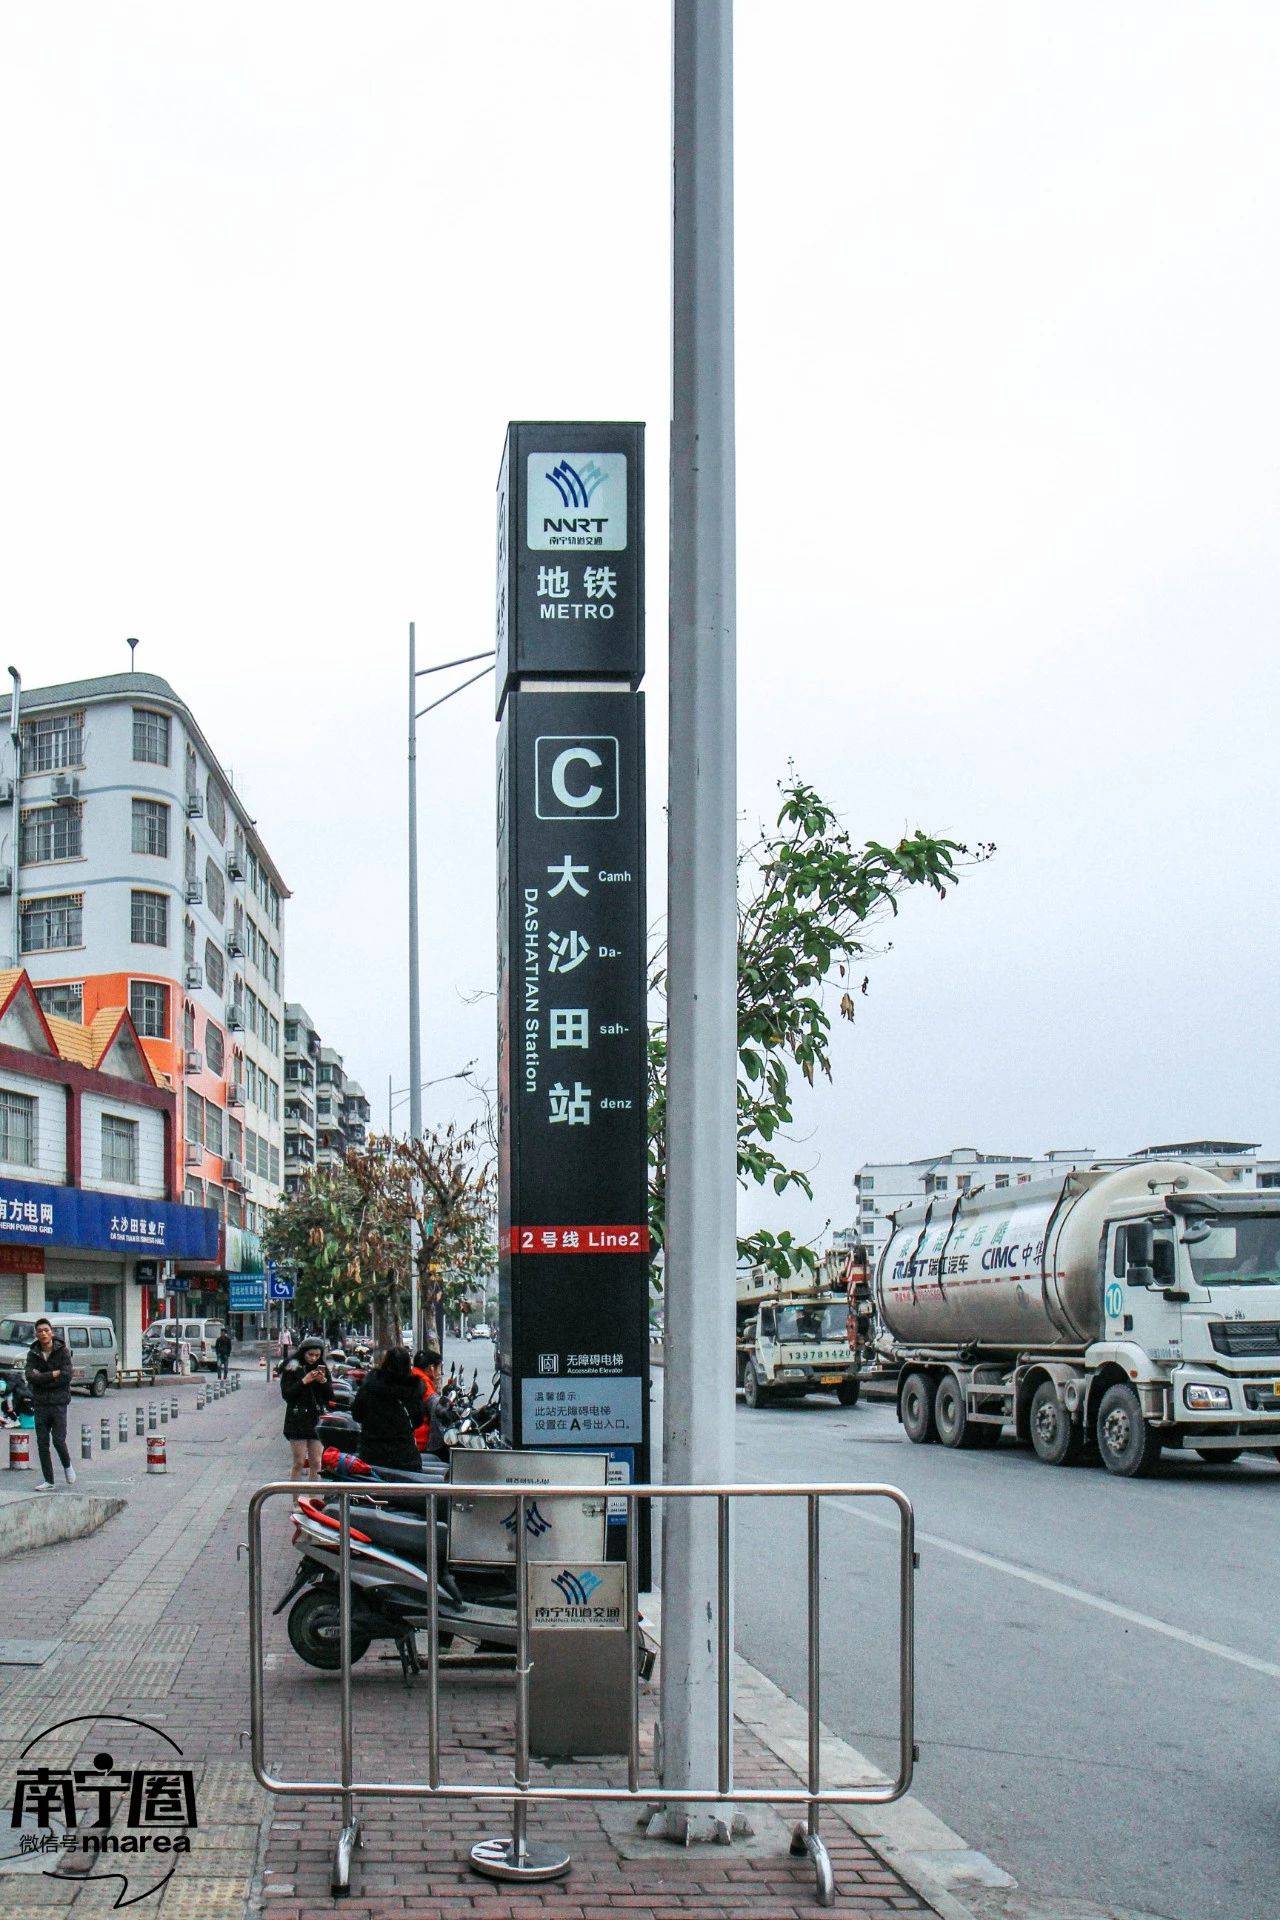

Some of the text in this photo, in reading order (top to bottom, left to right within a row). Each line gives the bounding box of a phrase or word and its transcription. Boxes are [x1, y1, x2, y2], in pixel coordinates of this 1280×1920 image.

[544, 518, 609, 533] NNRT
[537, 565, 617, 599] 地铁
[540, 603, 615, 619] METRO
[551, 747, 603, 809] C
[598, 870, 632, 882] Camh
[598, 946, 622, 958] Da-
[524, 888, 539, 1093] DASHATIAN Station
[547, 855, 592, 1126] 大沙田站
[599, 1023, 630, 1035] sah-
[599, 1098, 632, 1109] denz
[15, 1223, 38, 1233] POWER
[39, 1225, 53, 1234] GRID
[111, 1216, 166, 1236] 大沙田营业厅
[522, 1230, 640, 1249] 2号线 Line2
[981, 1244, 1020, 1271] CIMC
[1108, 1286, 1122, 1314] 10
[566, 1353, 624, 1366] 无障碍电梯
[534, 1391, 577, 1401] 温馨提示
[535, 1405, 612, 1417] 此站无障碍电梯
[535, 1606, 621, 1618] 南宁轨道交通
